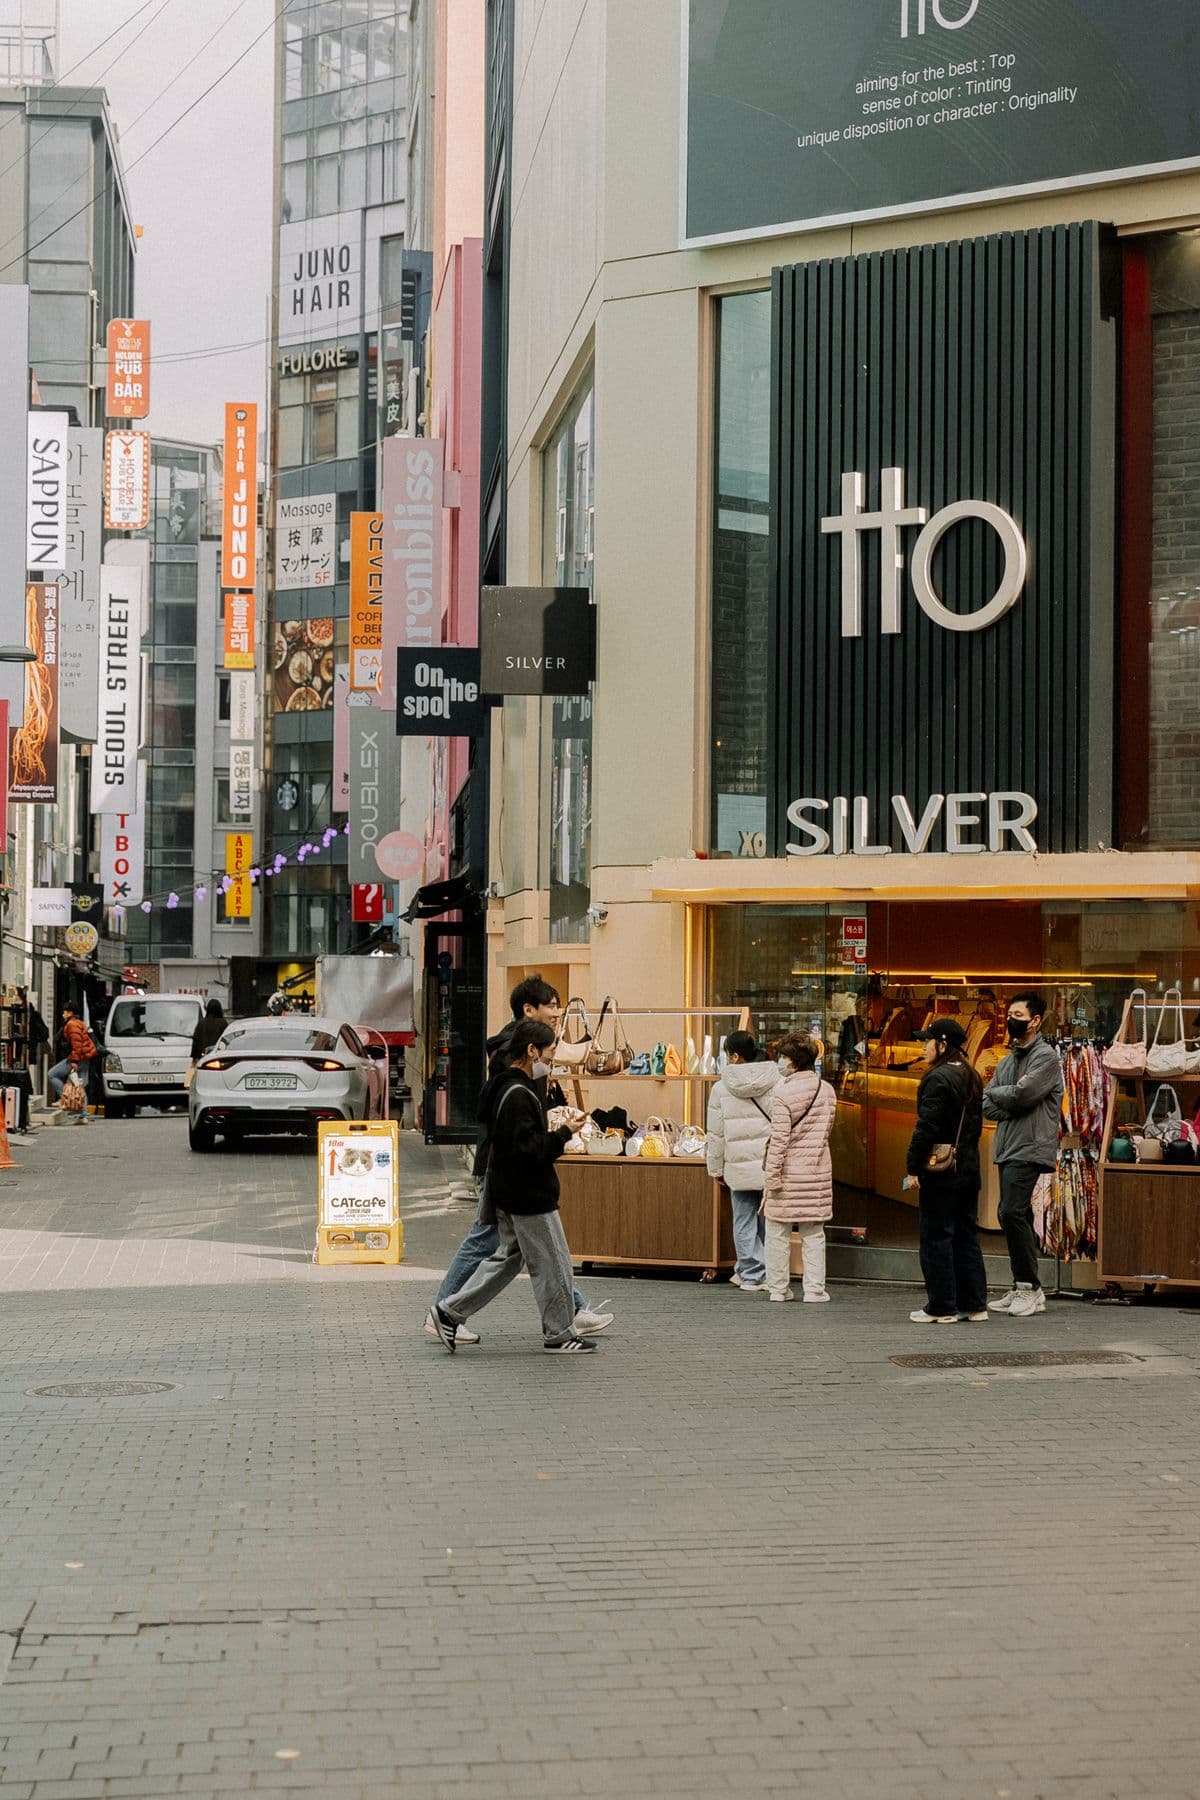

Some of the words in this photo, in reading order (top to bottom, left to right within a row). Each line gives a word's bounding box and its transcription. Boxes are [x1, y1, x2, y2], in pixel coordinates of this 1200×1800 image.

[855, 75, 898, 94] aiming
[902, 71, 920, 85] for
[923, 67, 945, 82] the
[949, 59, 978, 77] best
[989, 54, 1016, 69] Top
[862, 97, 901, 114] sense
[904, 91, 919, 107] of
[921, 87, 954, 104] color
[965, 77, 1011, 95] Tinting
[797, 129, 840, 147] unique
[843, 116, 913, 140] disposition
[917, 114, 931, 127] or
[933, 101, 998, 124] character
[1008, 86, 1078, 110] Originality
[294, 245, 351, 281] JUNO
[292, 280, 351, 315] HAIR
[115, 360, 142, 375] PUB
[281, 346, 348, 375] FULORE
[114, 382, 142, 398] BAR
[126, 458, 135, 505] HOLDEM
[31, 438, 60, 563] SAPPUN
[280, 502, 332, 517] Massage
[231, 479, 248, 579] JUNO
[281, 552, 331, 572] マッサージ
[392, 449, 433, 647] renbliss
[821, 467, 1027, 638] tto
[315, 572, 330, 584] 5F
[107, 594, 128, 690] STREET
[353, 635, 382, 645] COCK
[414, 662, 444, 687] On
[505, 656, 566, 669] SILVER
[443, 677, 478, 702] the
[105, 702, 126, 786] SEOUL
[234, 750, 250, 810] 명동피자
[360, 731, 379, 859] DOUBLEX
[785, 791, 1039, 857] SILVER
[738, 831, 767, 858] XO
[331, 1197, 386, 1208] CATcafe
